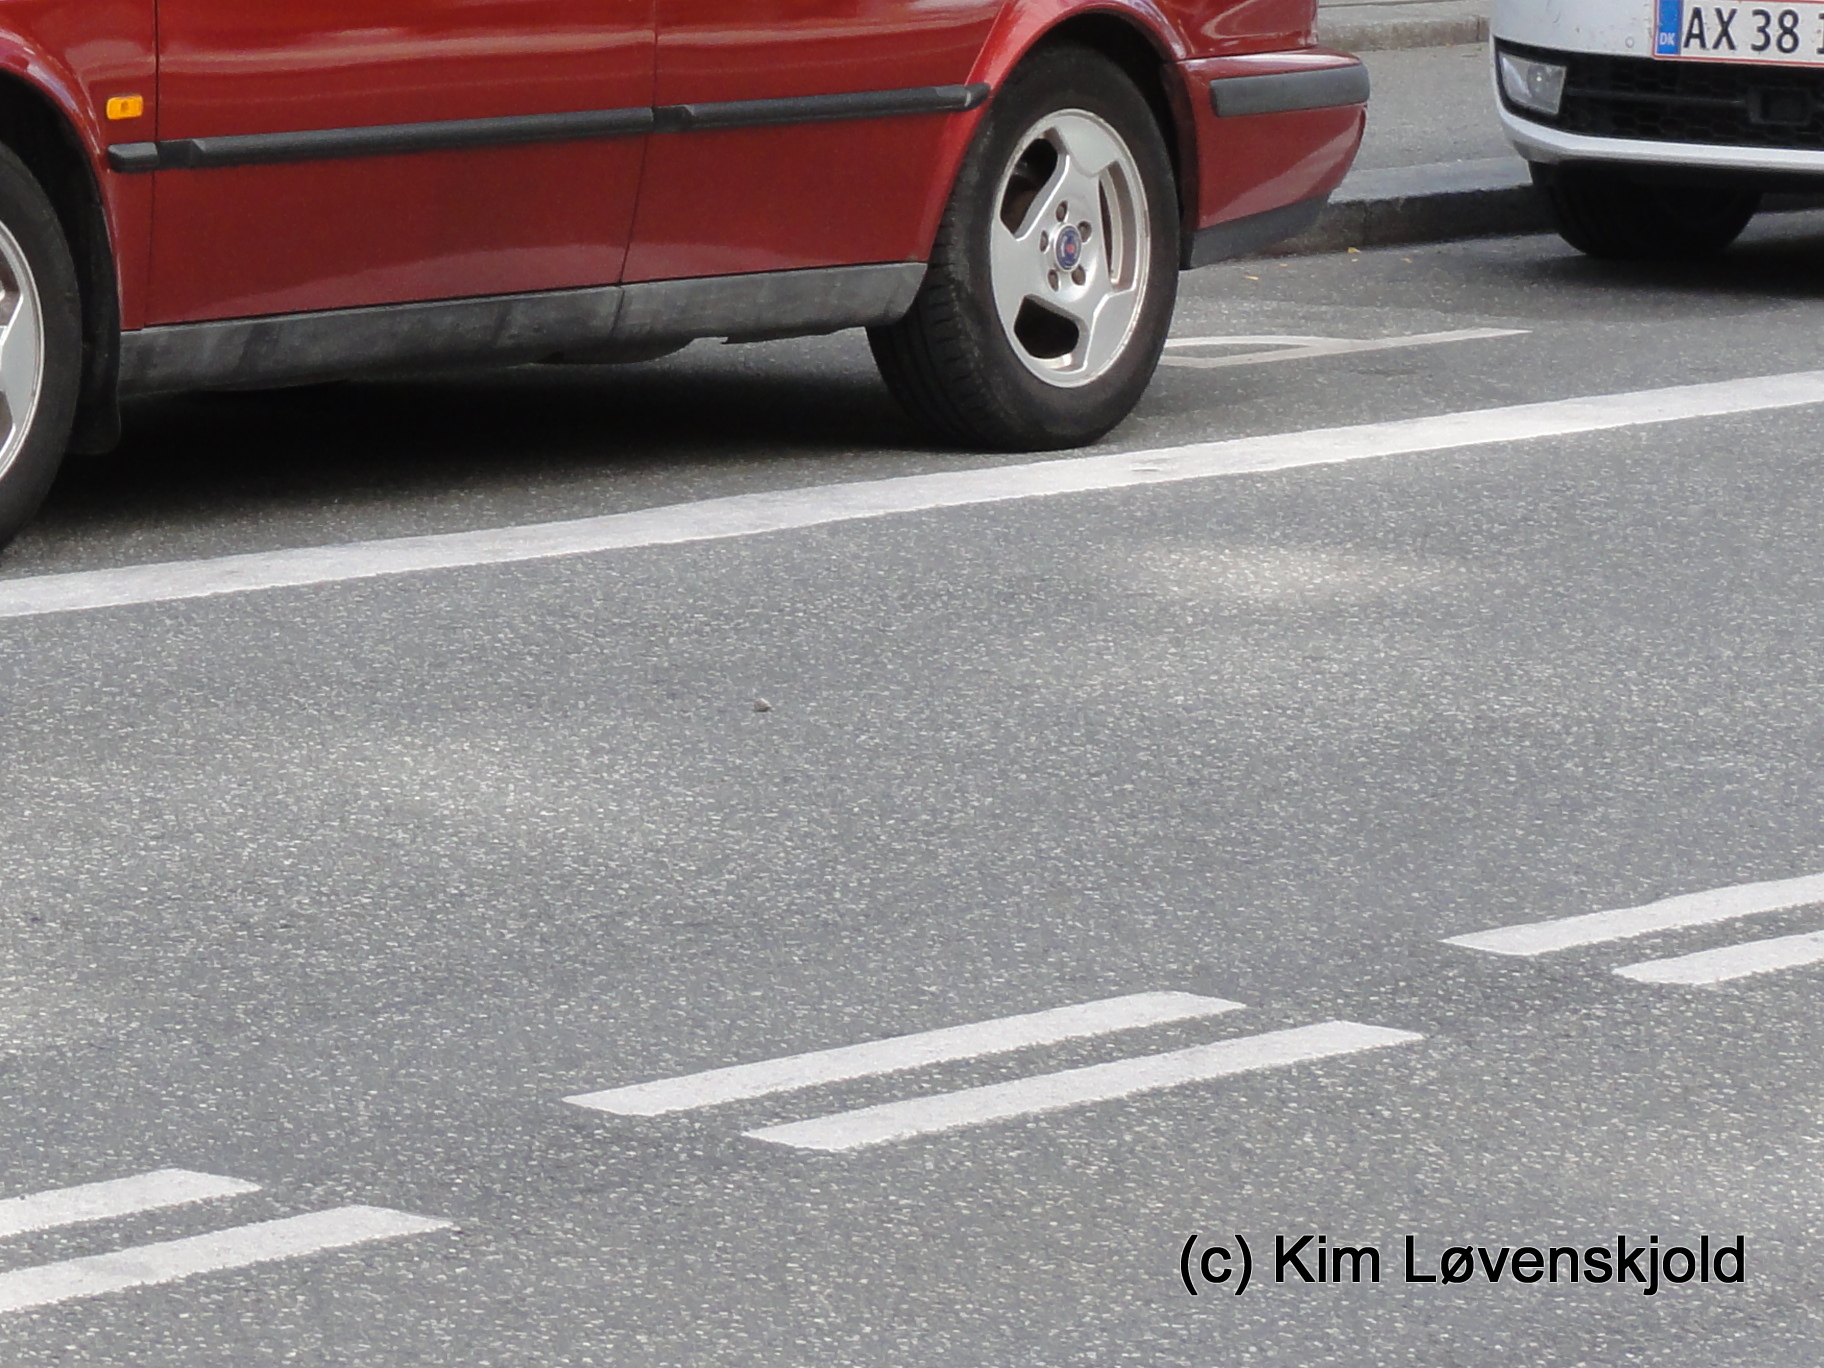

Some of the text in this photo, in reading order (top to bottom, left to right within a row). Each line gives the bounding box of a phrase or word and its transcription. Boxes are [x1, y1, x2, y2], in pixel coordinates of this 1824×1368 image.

[1659, 32, 1675, 46] DK
[1683, 6, 1738, 50] AX
[1750, 9, 1799, 54] 38
